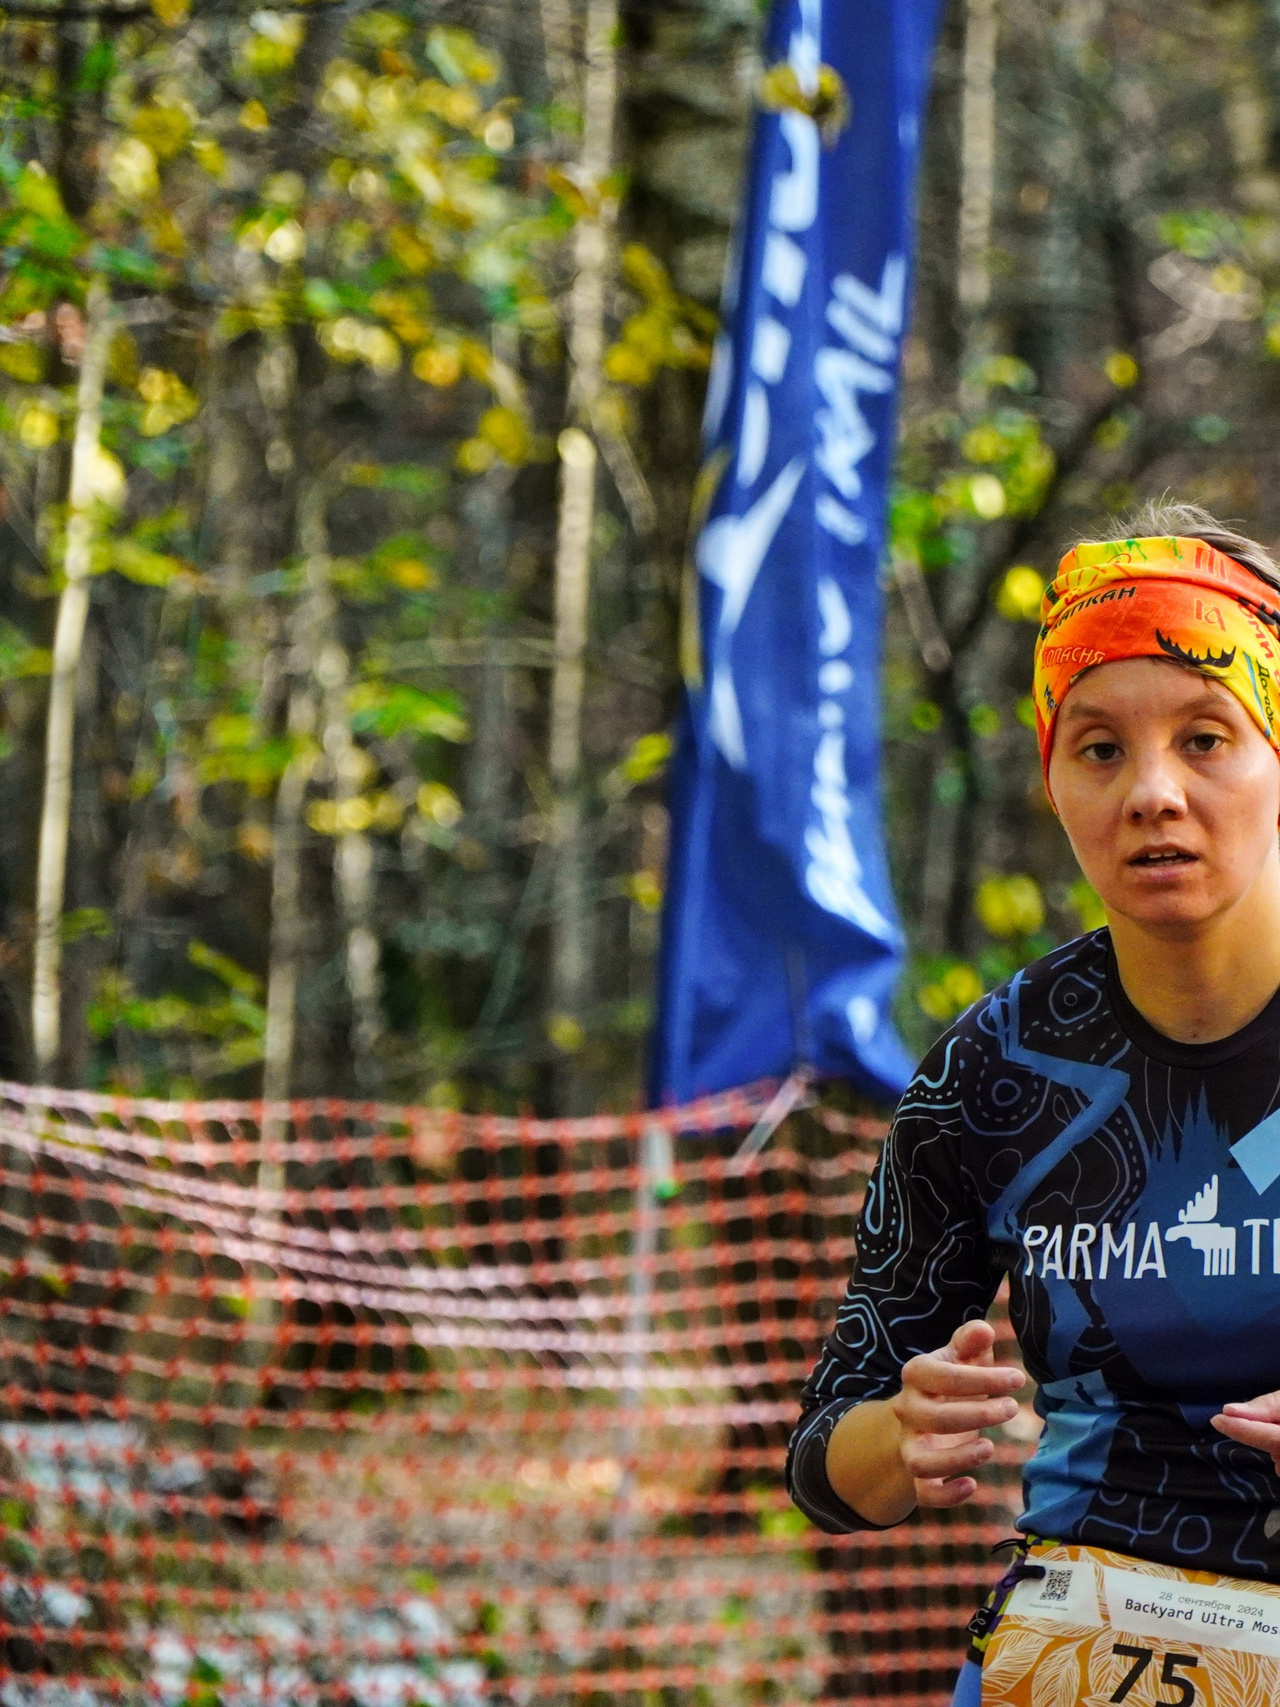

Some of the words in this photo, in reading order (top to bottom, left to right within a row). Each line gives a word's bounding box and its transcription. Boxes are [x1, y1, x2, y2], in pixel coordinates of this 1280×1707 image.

[1024, 1221, 1168, 1280] PARMA
[1124, 1598, 1195, 1622] Backyard
[1200, 1611, 1245, 1630] Ultra
[1158, 1591, 1173, 1601] 28
[1177, 1596, 1232, 1612] сентября
[1236, 1604, 1264, 1618] 2024
[1108, 1642, 1199, 1707] 75
